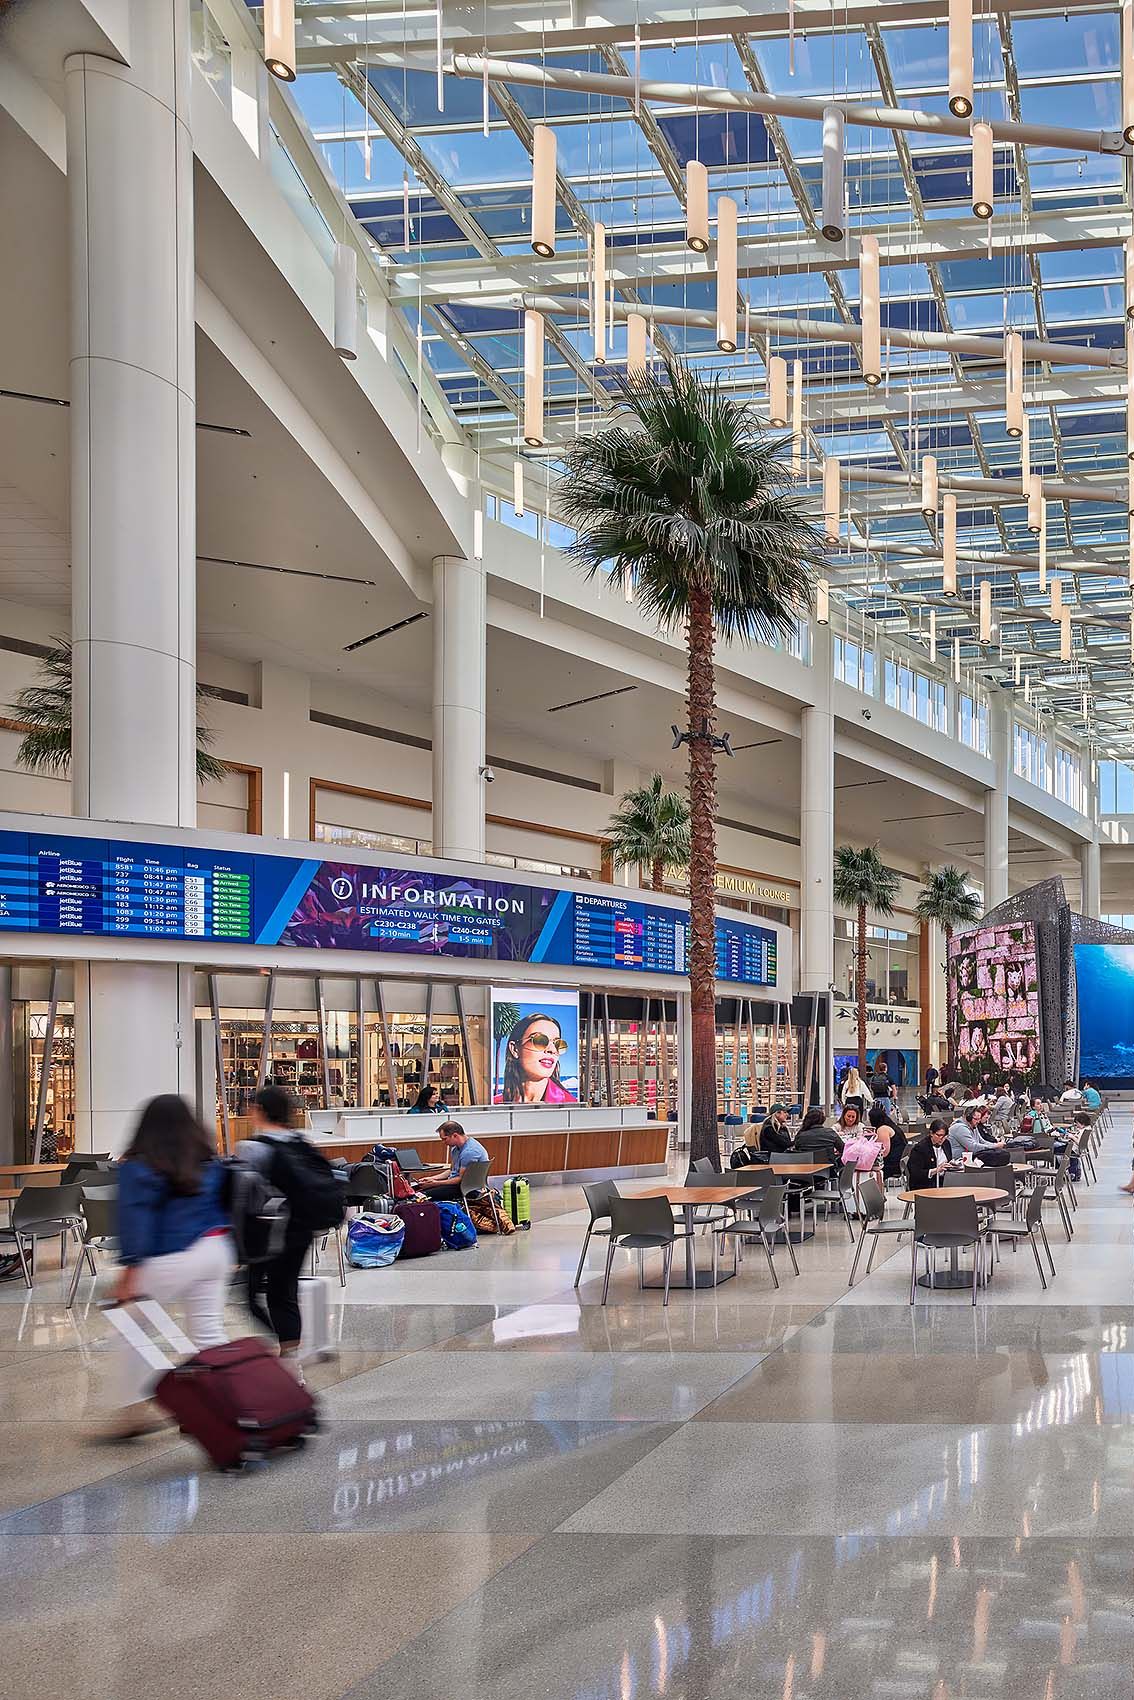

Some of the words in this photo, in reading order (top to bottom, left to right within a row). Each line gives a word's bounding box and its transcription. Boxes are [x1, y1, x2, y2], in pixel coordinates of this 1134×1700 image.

[714, 874, 756, 895] EMIUM
[758, 888, 790, 901] LOUNGE
[362, 883, 525, 914] INFORMATION
[584, 897, 627, 909] DEPARTURES
[360, 906, 411, 918] ESTIMATED
[413, 911, 439, 920] WALK
[441, 914, 461, 922] TIME
[476, 917, 501, 926] GATES
[374, 921, 416, 929] C230-C238
[452, 927, 489, 936] C240-C245
[853, 1008, 893, 1023] SWorld
